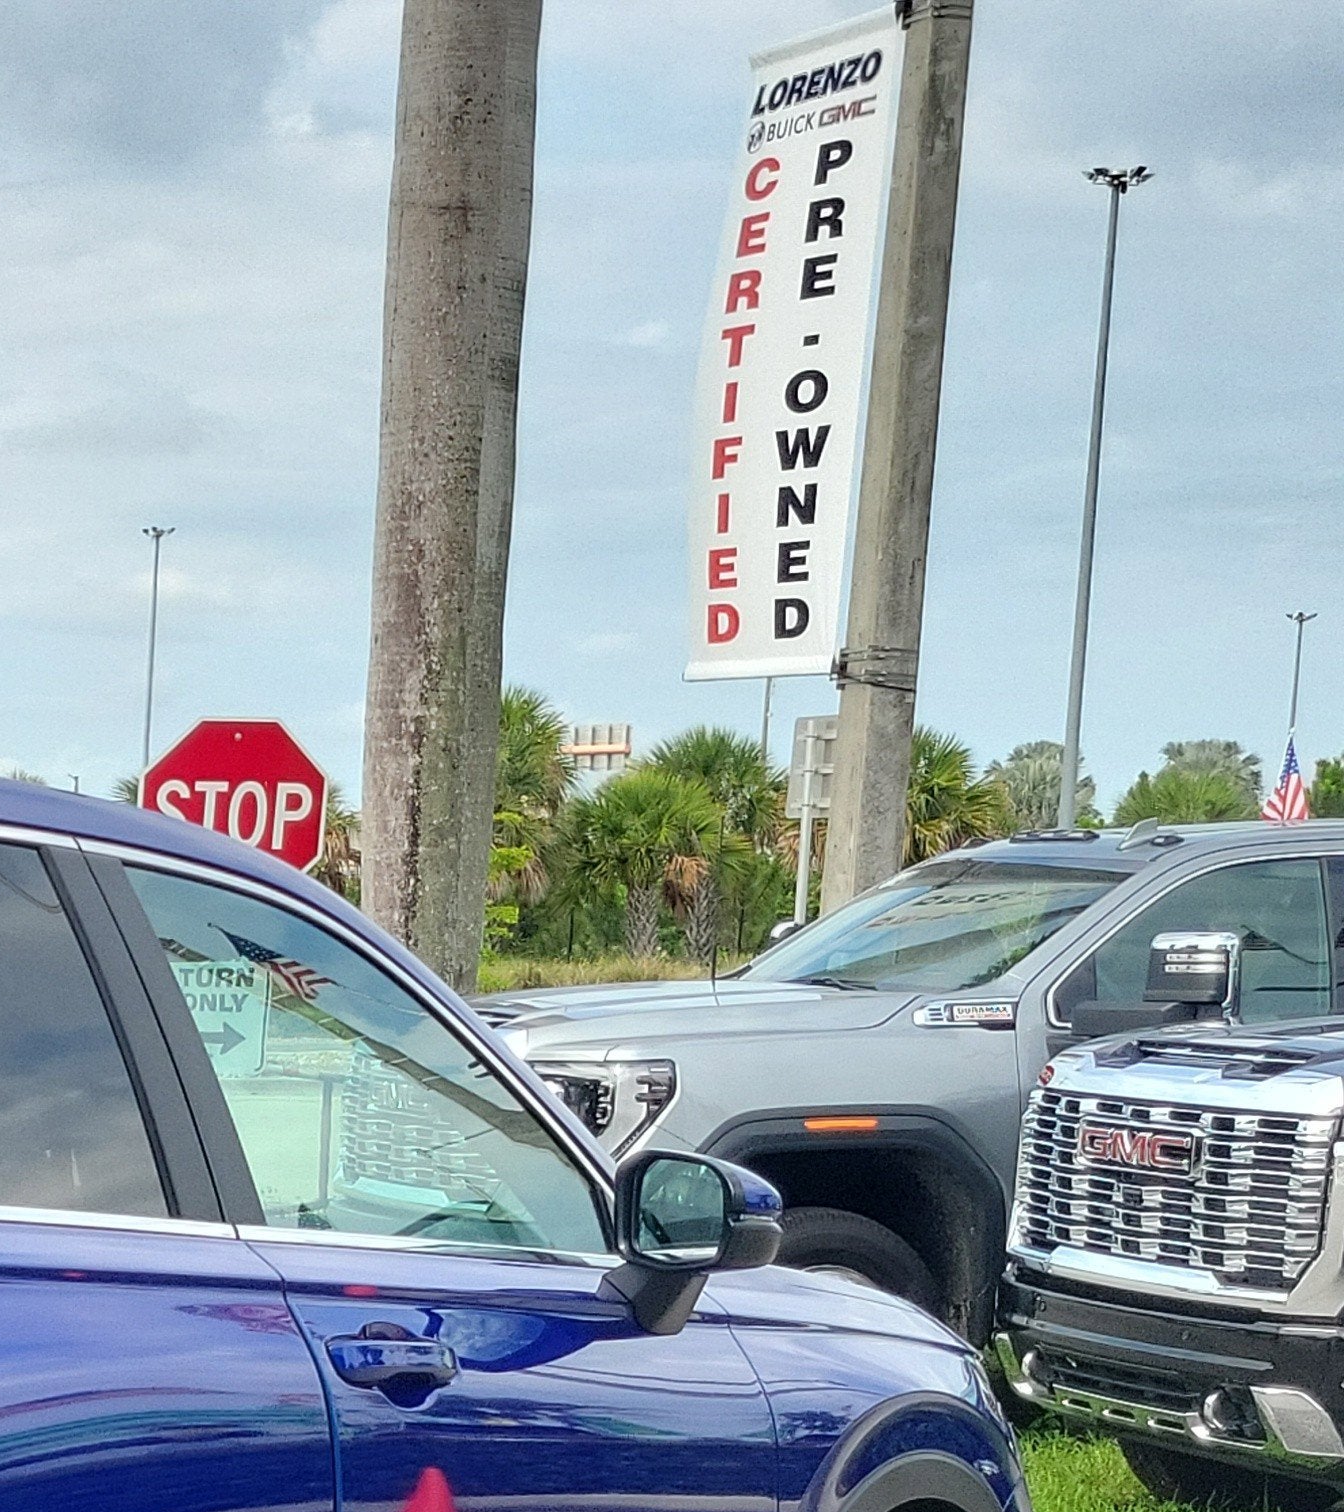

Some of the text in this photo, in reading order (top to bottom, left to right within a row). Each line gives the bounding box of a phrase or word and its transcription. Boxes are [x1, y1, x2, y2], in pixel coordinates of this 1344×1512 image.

[751, 49, 883, 118] LORENZO
[766, 95, 877, 142] BUICK GMC
[707, 157, 780, 645] CERTIFIED
[156, 780, 312, 850] STOP
[179, 966, 256, 988] TURN
[185, 993, 249, 1013] ONLY
[1081, 1129, 1191, 1169] GMC
